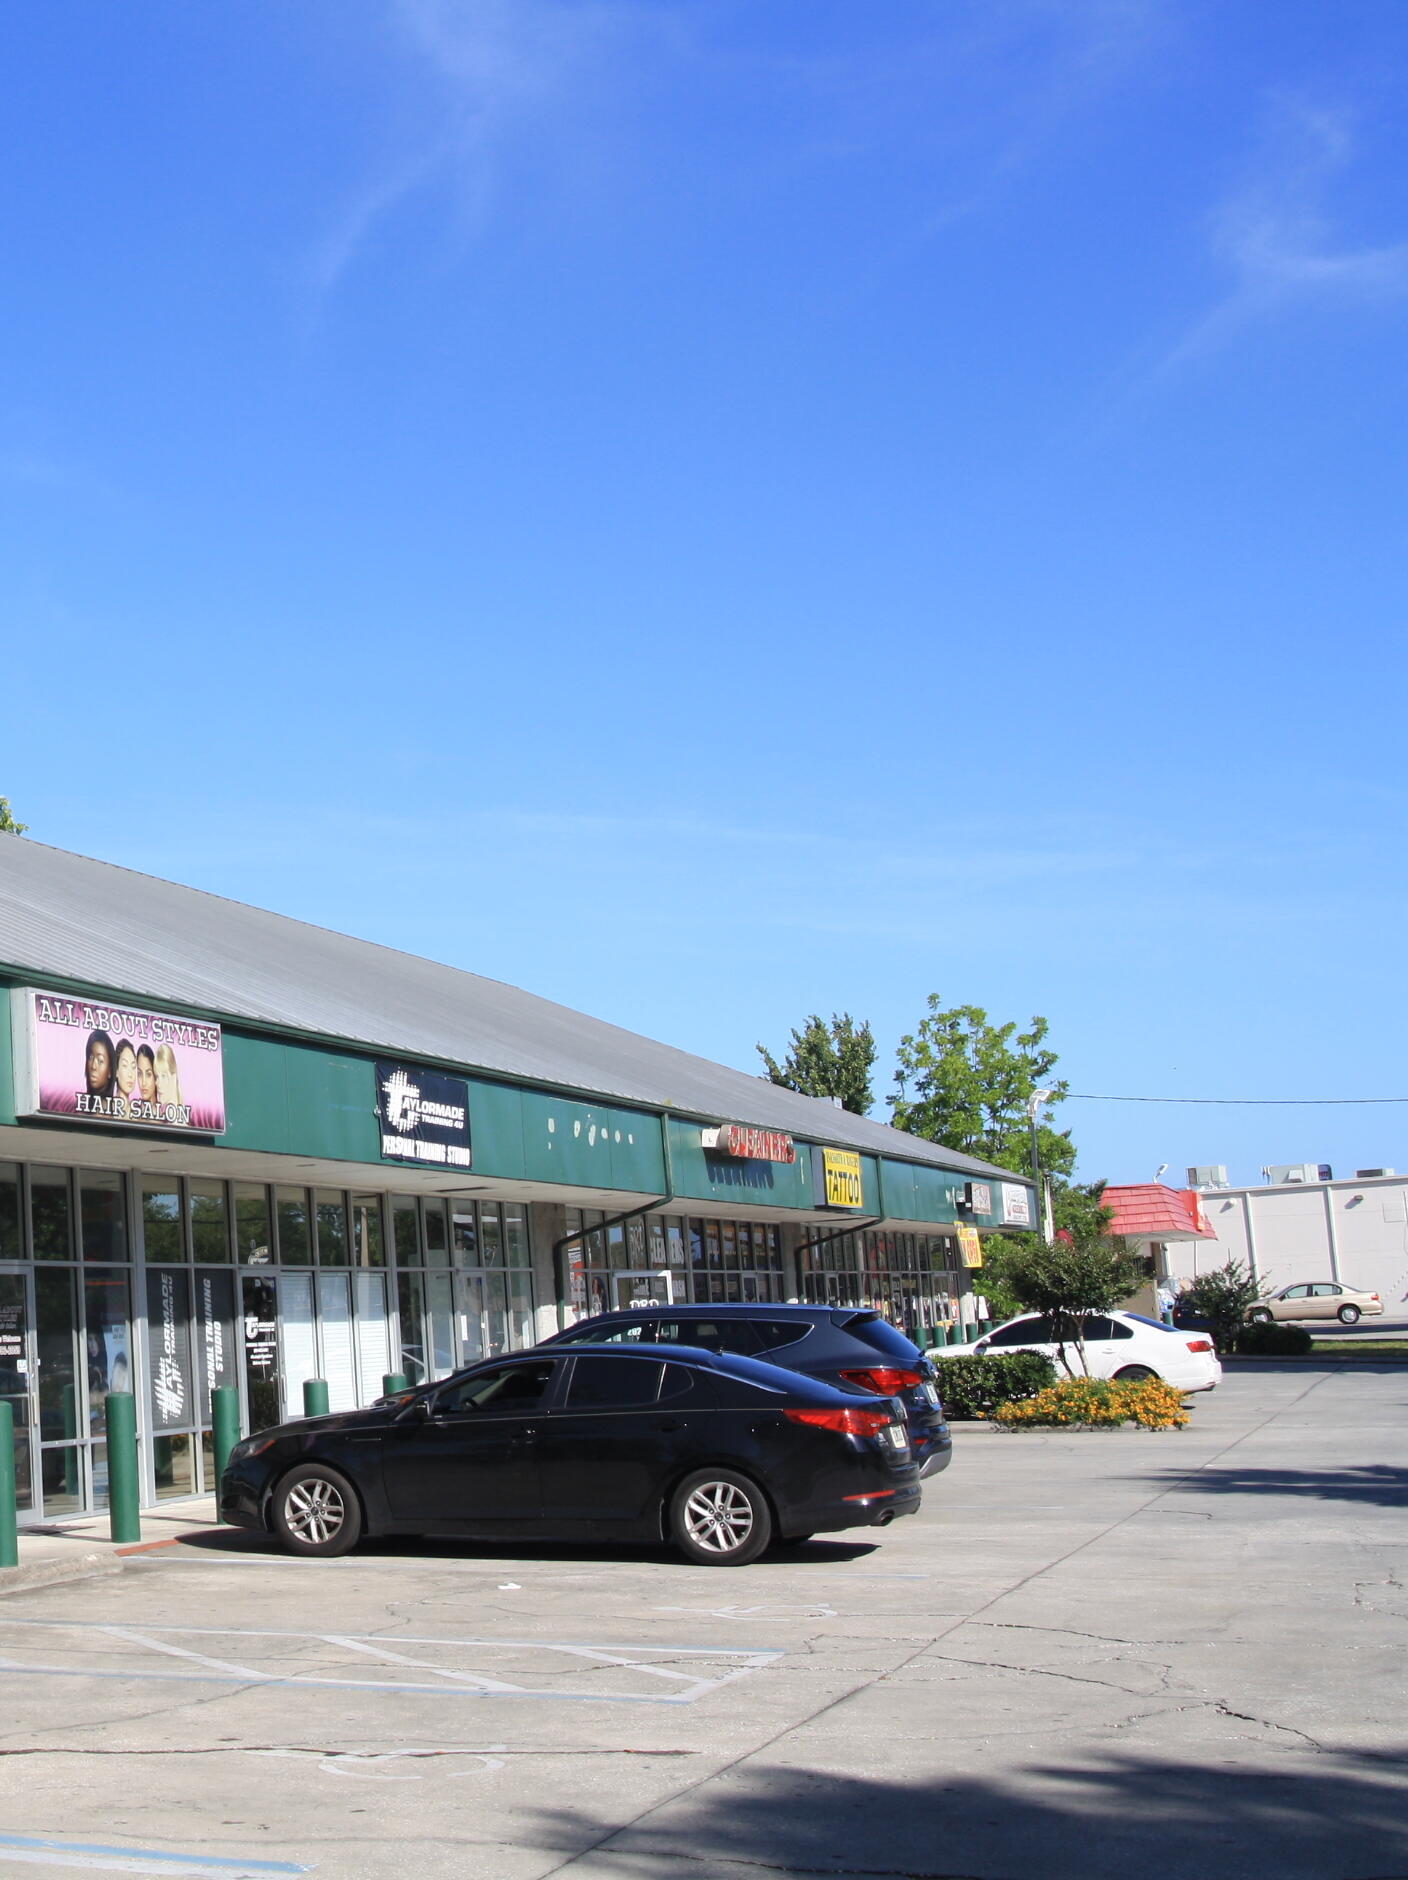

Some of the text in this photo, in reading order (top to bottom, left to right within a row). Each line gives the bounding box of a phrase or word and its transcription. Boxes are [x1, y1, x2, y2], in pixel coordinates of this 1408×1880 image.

[39, 999, 219, 1051] ALL ABOUT STYLES
[75, 1093, 191, 1125] HAIR SALON
[421, 1114, 453, 1128] TRAINING
[415, 1139, 446, 1163] TRAINING
[827, 1168, 860, 1204] TATTOO
[203, 1278, 214, 1343] TRAINING
[213, 1321, 223, 1373] STUDIO
